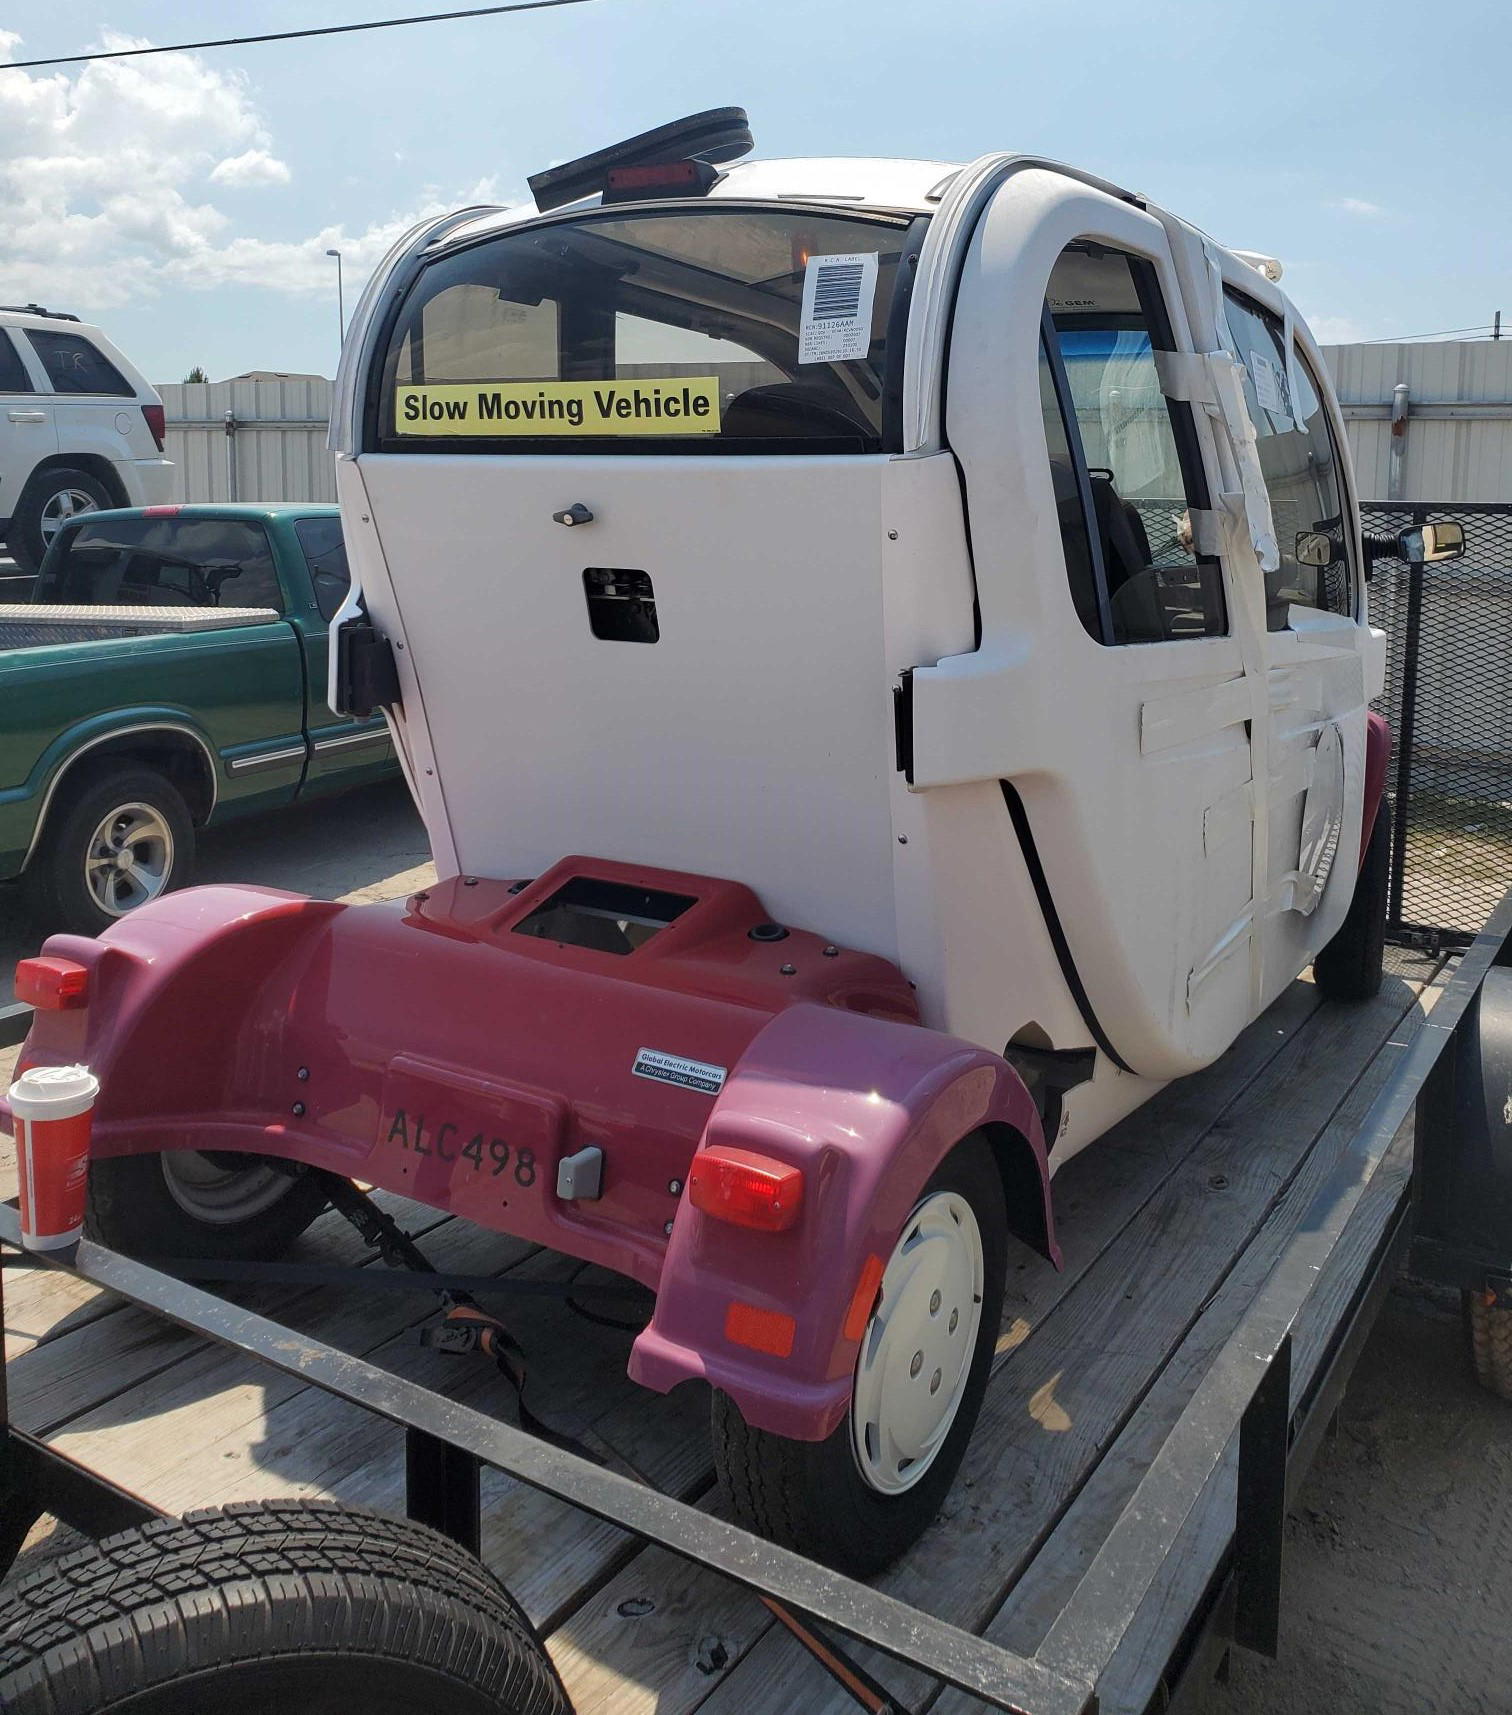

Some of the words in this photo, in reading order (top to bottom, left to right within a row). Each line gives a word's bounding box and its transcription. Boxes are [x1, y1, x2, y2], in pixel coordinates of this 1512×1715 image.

[404, 394, 468, 421] Slow
[478, 392, 584, 426] Moving
[593, 388, 710, 419] Vehicle
[641, 1053, 664, 1065] Global
[664, 1059, 688, 1072] Electric
[689, 1066, 722, 1080] Motorcars
[646, 1065, 670, 1077] Chrysler
[670, 1072, 688, 1083] Group
[688, 1077, 717, 1090] Company
